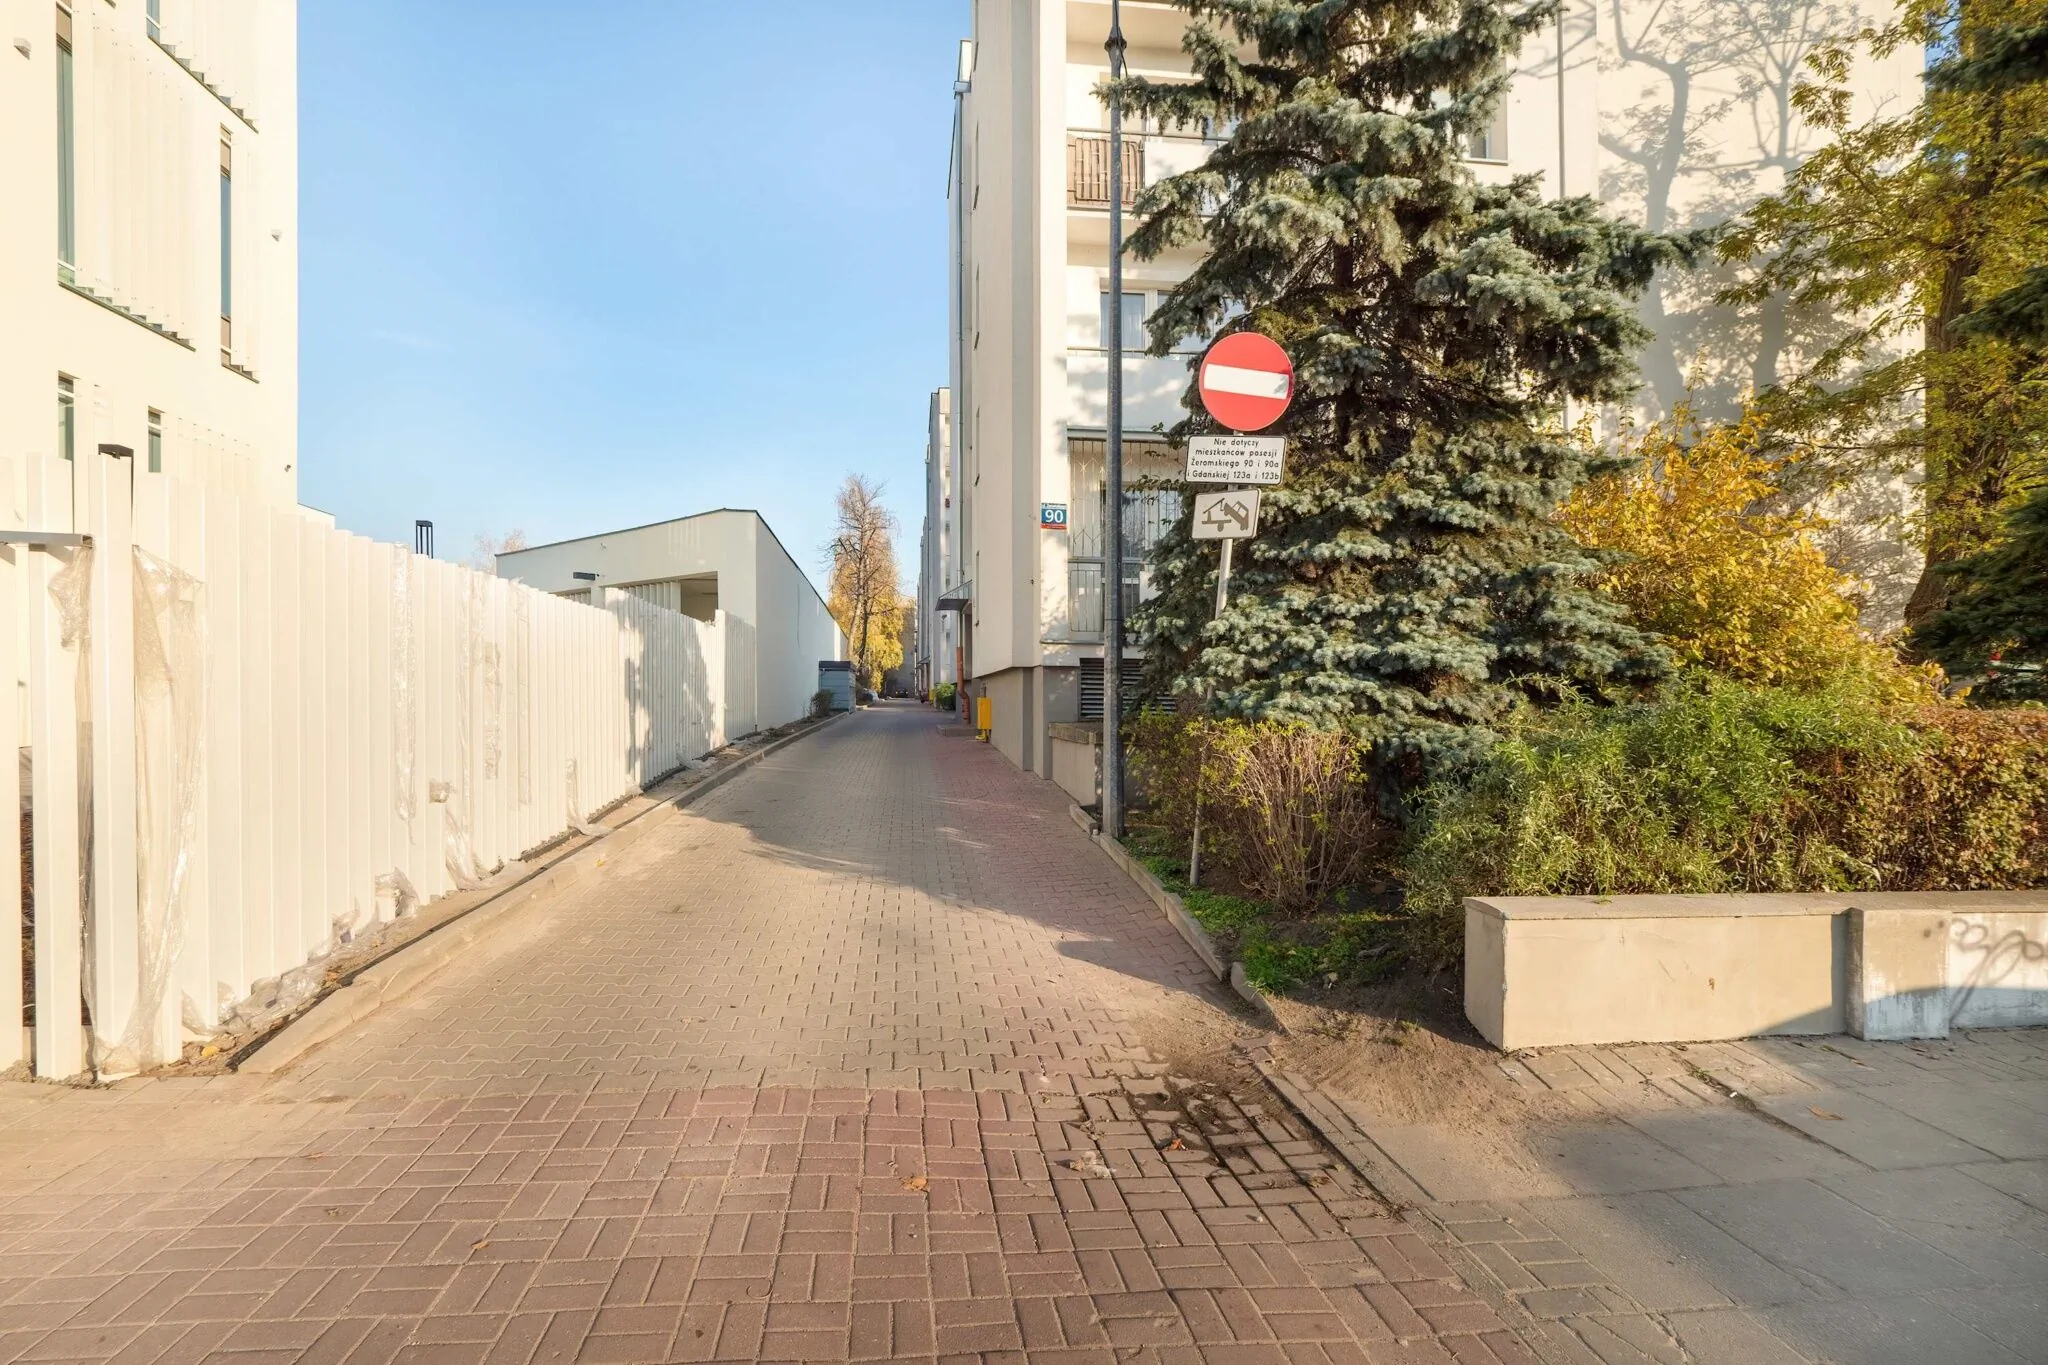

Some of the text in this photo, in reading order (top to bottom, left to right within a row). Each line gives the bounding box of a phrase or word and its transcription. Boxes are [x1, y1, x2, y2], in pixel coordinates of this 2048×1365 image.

[1230, 438, 1259, 448] dotyczy
[1249, 449, 1277, 458] posesji
[1191, 456, 1240, 468] Żeromskiego
[1264, 460, 1279, 468] 90a
[1233, 471, 1251, 479] 123a
[1261, 472, 1279, 480] 123b
[1045, 510, 1064, 523] 90
